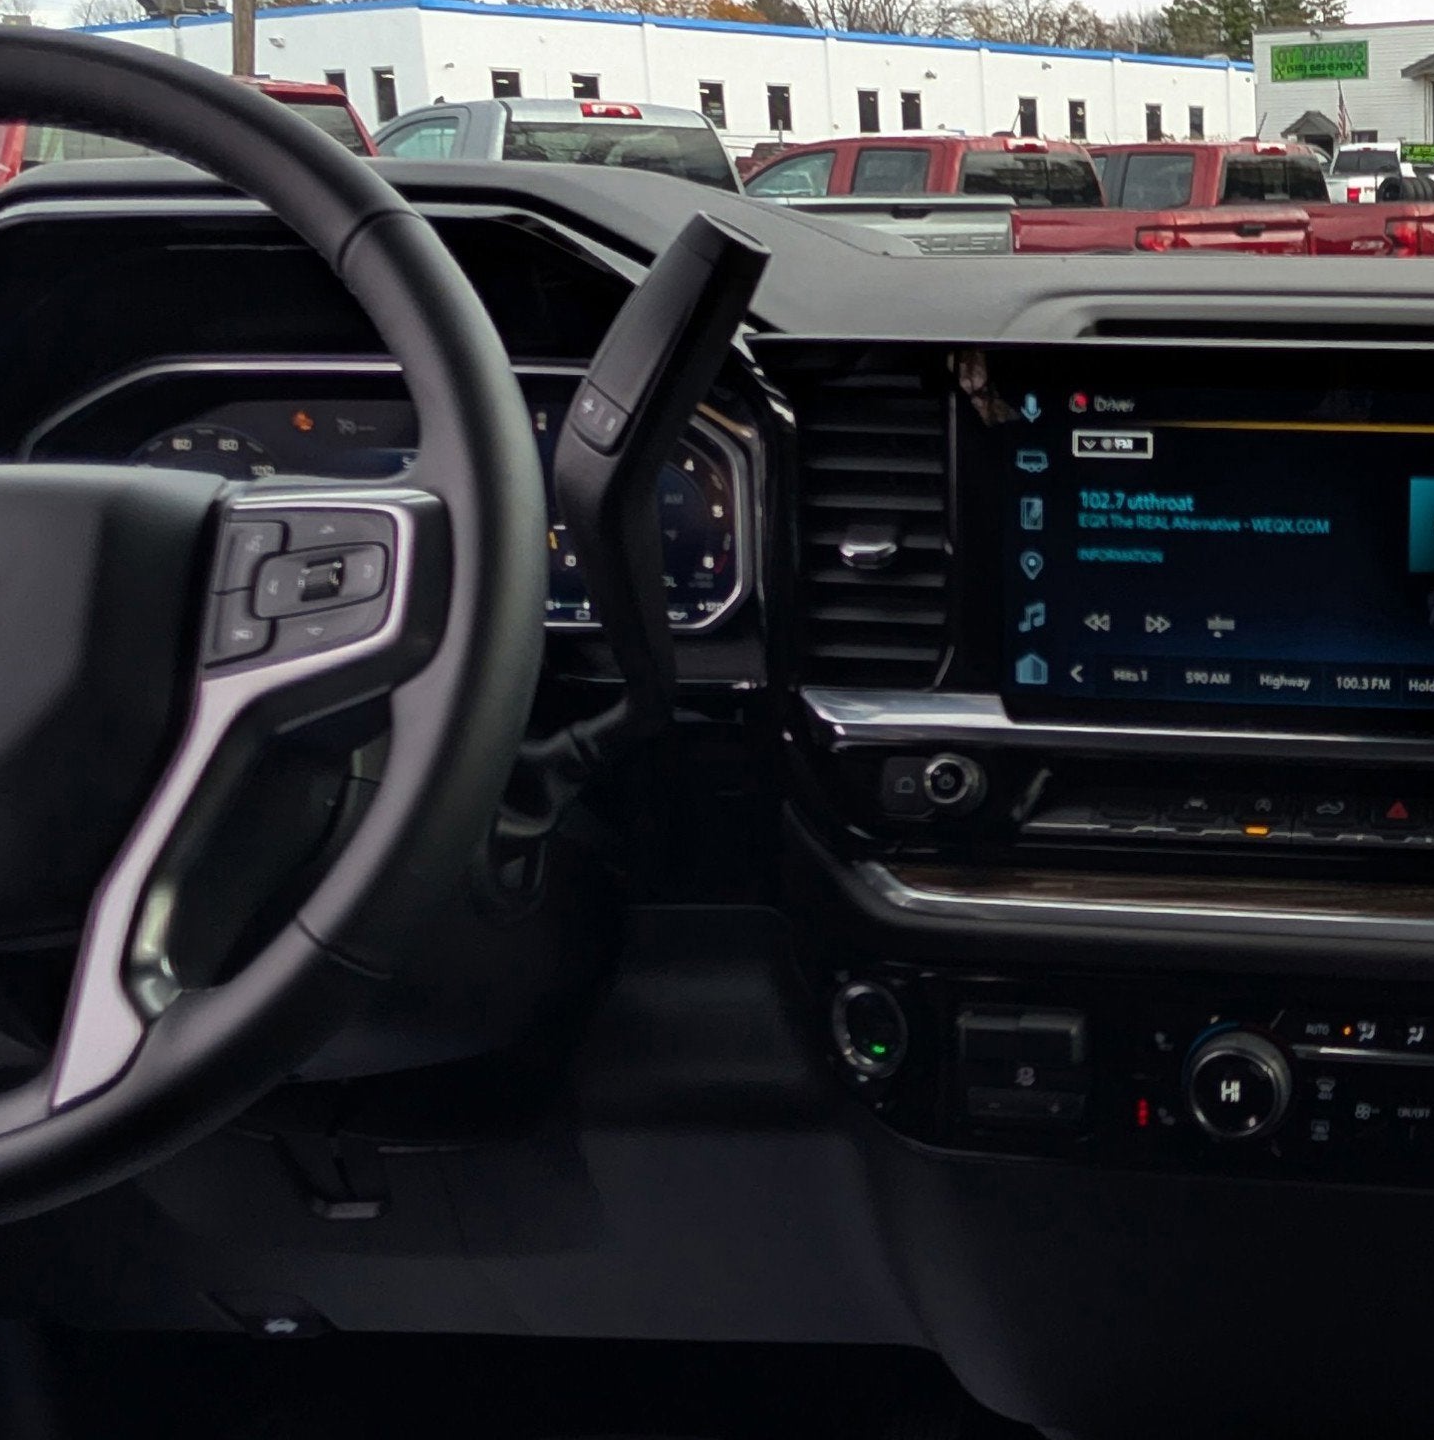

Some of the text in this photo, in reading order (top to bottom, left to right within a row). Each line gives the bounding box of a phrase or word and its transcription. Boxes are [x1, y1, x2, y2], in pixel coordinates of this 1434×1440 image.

[1094, 398, 1136, 413] Driver
[1079, 491, 1125, 511] 102.7
[1251, 518, 1330, 535] WEQX.COM
[1185, 671, 1231, 685] 590 AM
[1259, 674, 1311, 691] Highway
[1336, 676, 1391, 691] 100.3 FM
[1305, 1023, 1330, 1038] AUTO
[1220, 1079, 1242, 1103] HI
